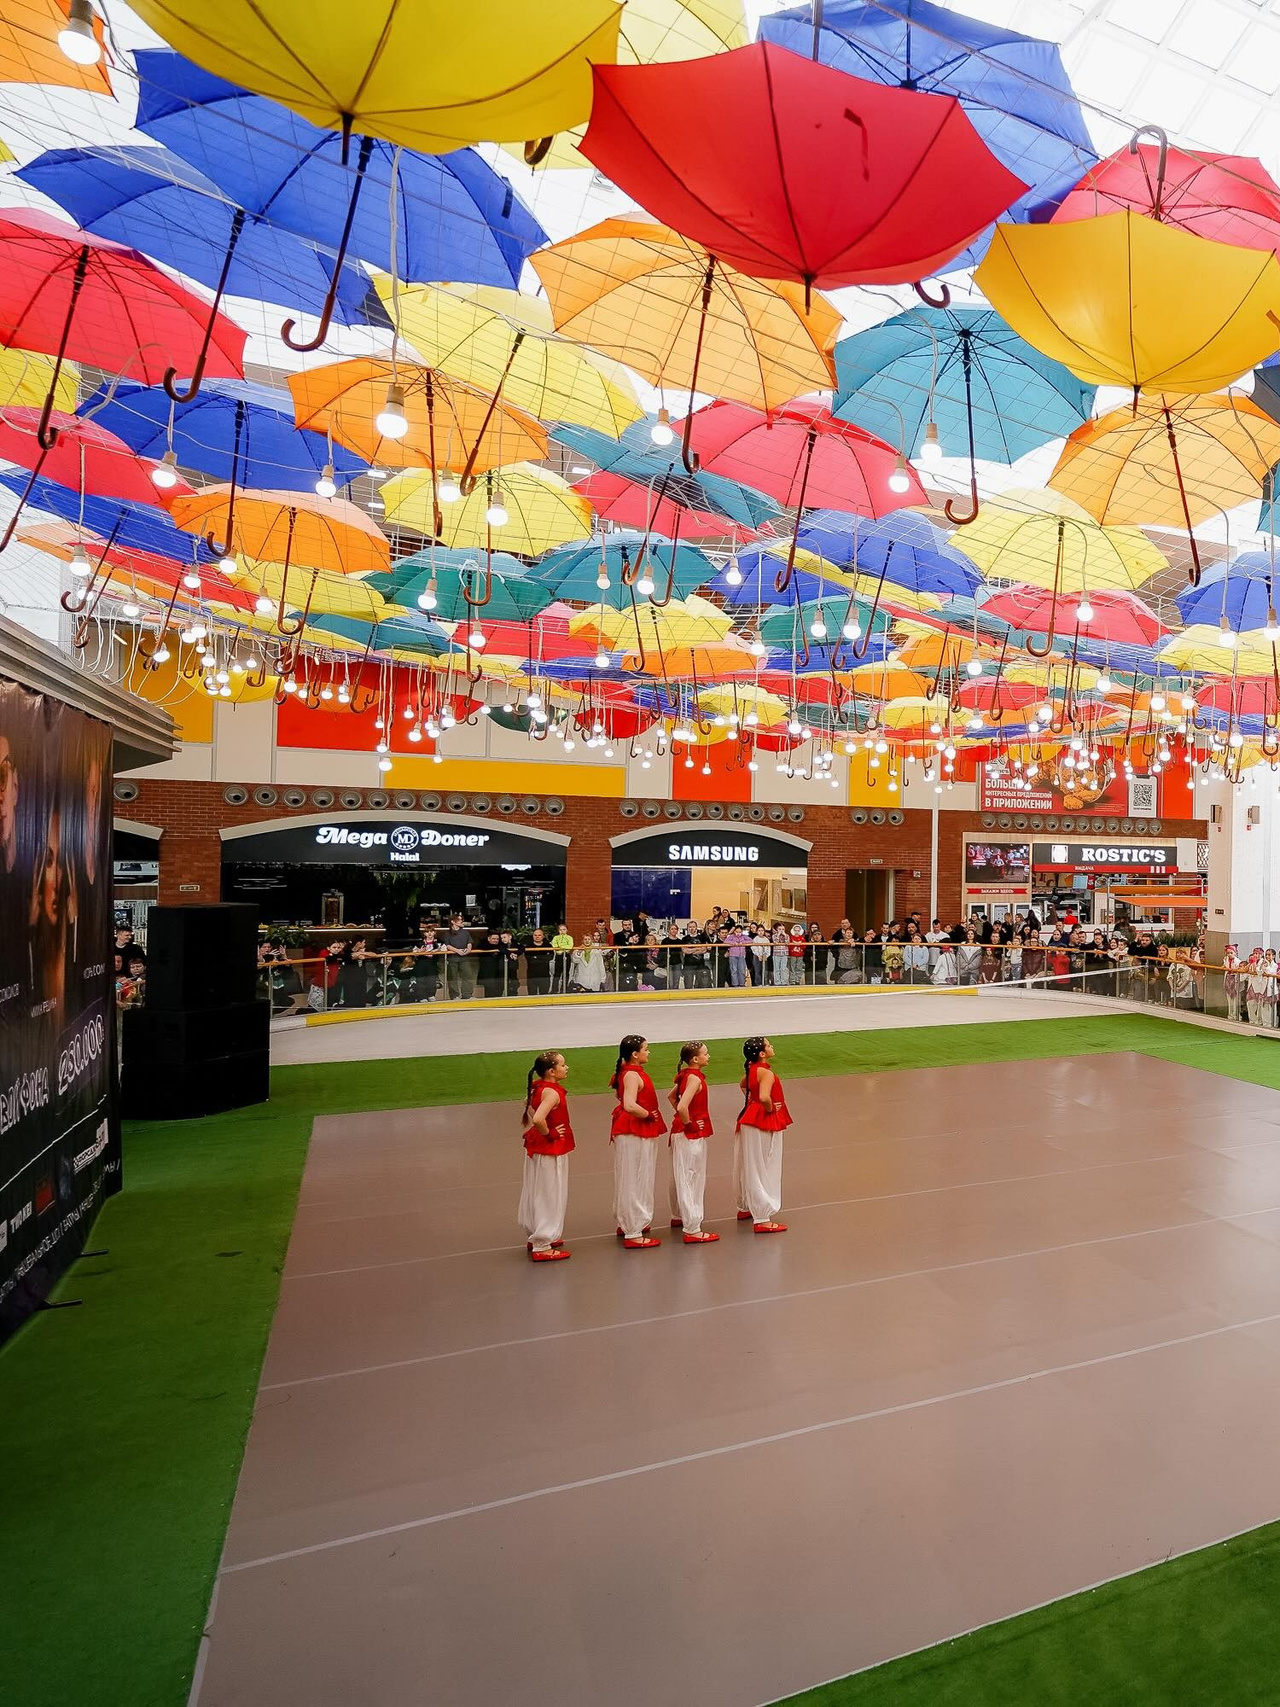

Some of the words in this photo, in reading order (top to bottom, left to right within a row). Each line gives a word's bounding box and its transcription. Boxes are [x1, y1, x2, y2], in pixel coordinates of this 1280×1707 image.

[985, 778, 1020, 789] БОЛЬШ
[985, 798, 991, 807] В
[993, 798, 1052, 809] ПРИЛОЖЕНИИ
[315, 827, 388, 848] Mega
[421, 829, 490, 847] Doner
[390, 852, 420, 862] Halal
[669, 844, 759, 861] SAMSUNG
[1081, 847, 1166, 863] ROSTIC'S
